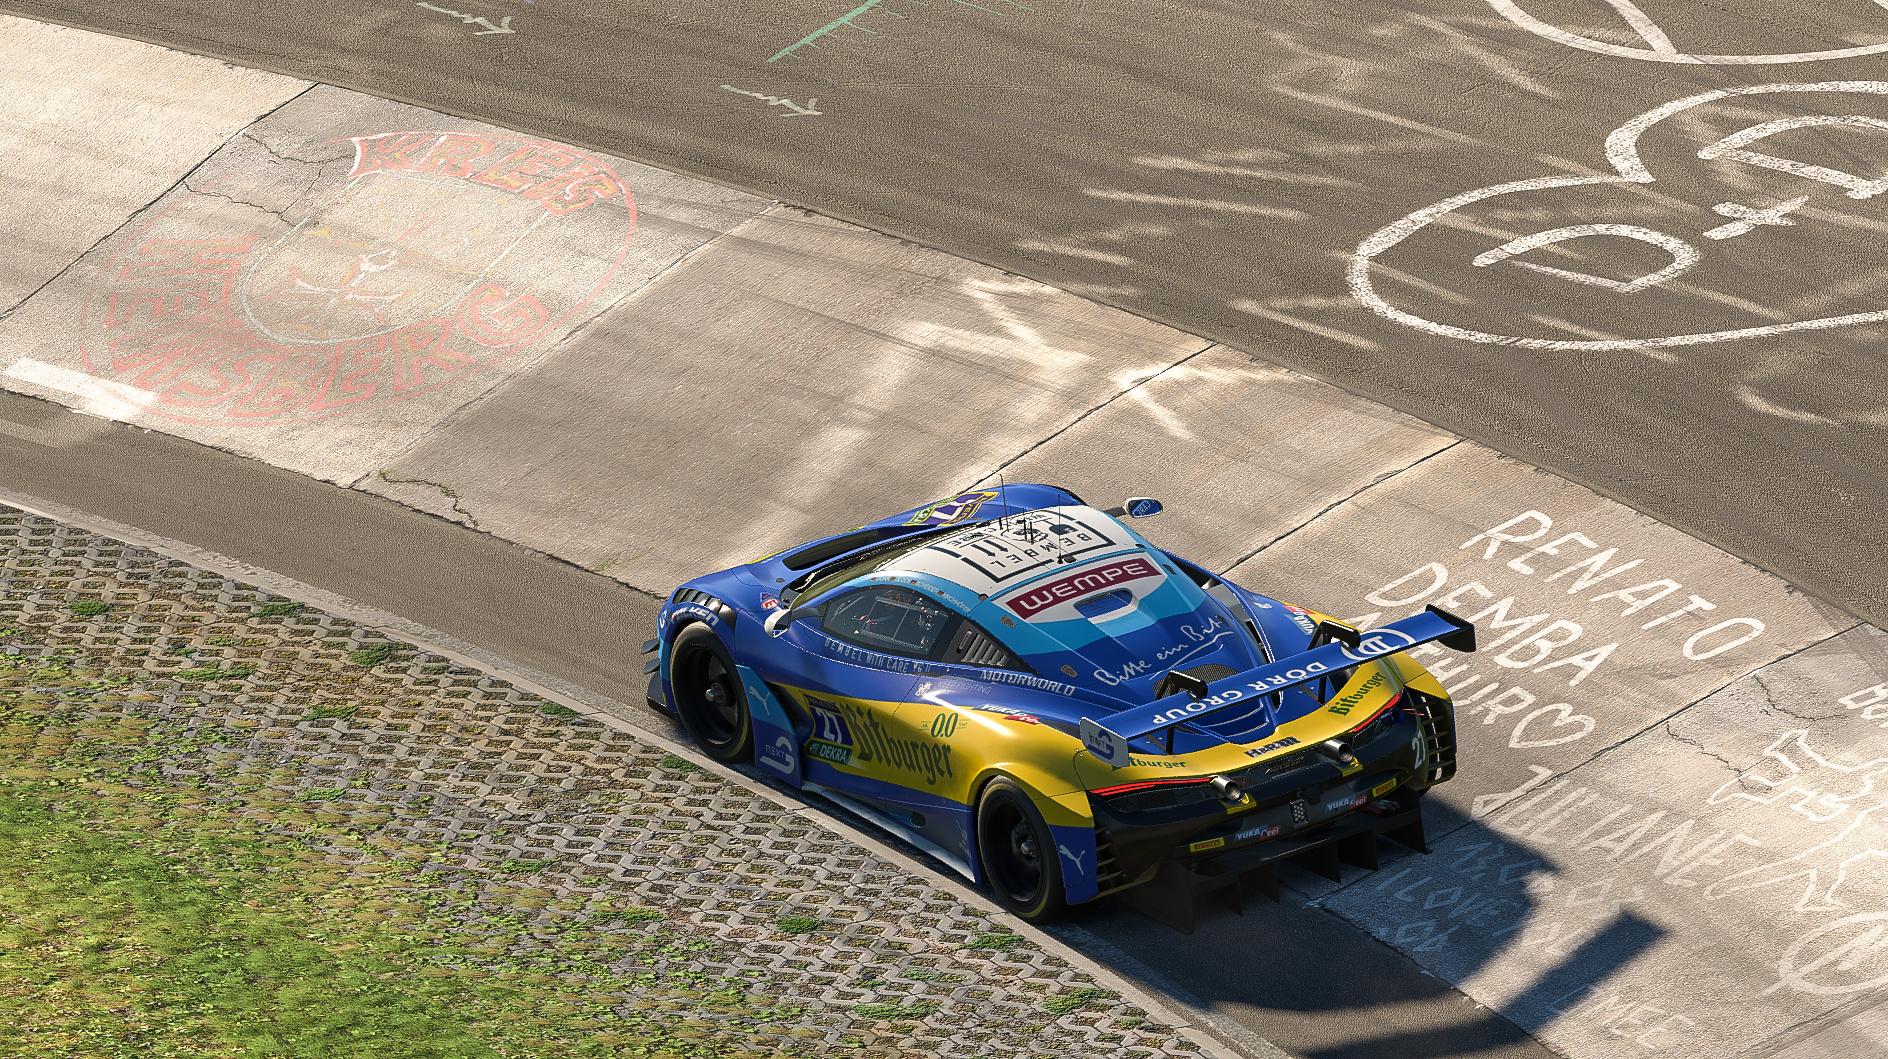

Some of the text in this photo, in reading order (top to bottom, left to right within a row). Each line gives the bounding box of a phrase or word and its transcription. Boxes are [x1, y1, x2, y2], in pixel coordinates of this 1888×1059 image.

[990, 532, 1092, 568] BEMBEL
[1018, 561, 1149, 611] WEMPE
[1460, 509, 1765, 662] RENATO
[1364, 562, 1618, 687] DEMBA
[865, 652, 885, 668] WITH
[886, 657, 910, 674] CARE
[1093, 615, 1223, 686] Bitte ein Bit
[980, 669, 1076, 697] MOTORWORLD
[1151, 660, 1329, 726] DÖRR GROUP
[1328, 671, 1387, 717] Bitburger
[815, 706, 842, 745] 27
[839, 701, 954, 786] Bitburger
[930, 711, 959, 738] 0.0
[820, 744, 848, 763] DEKRA
[1126, 756, 1187, 769] tburger
[1411, 729, 1426, 770] 27
